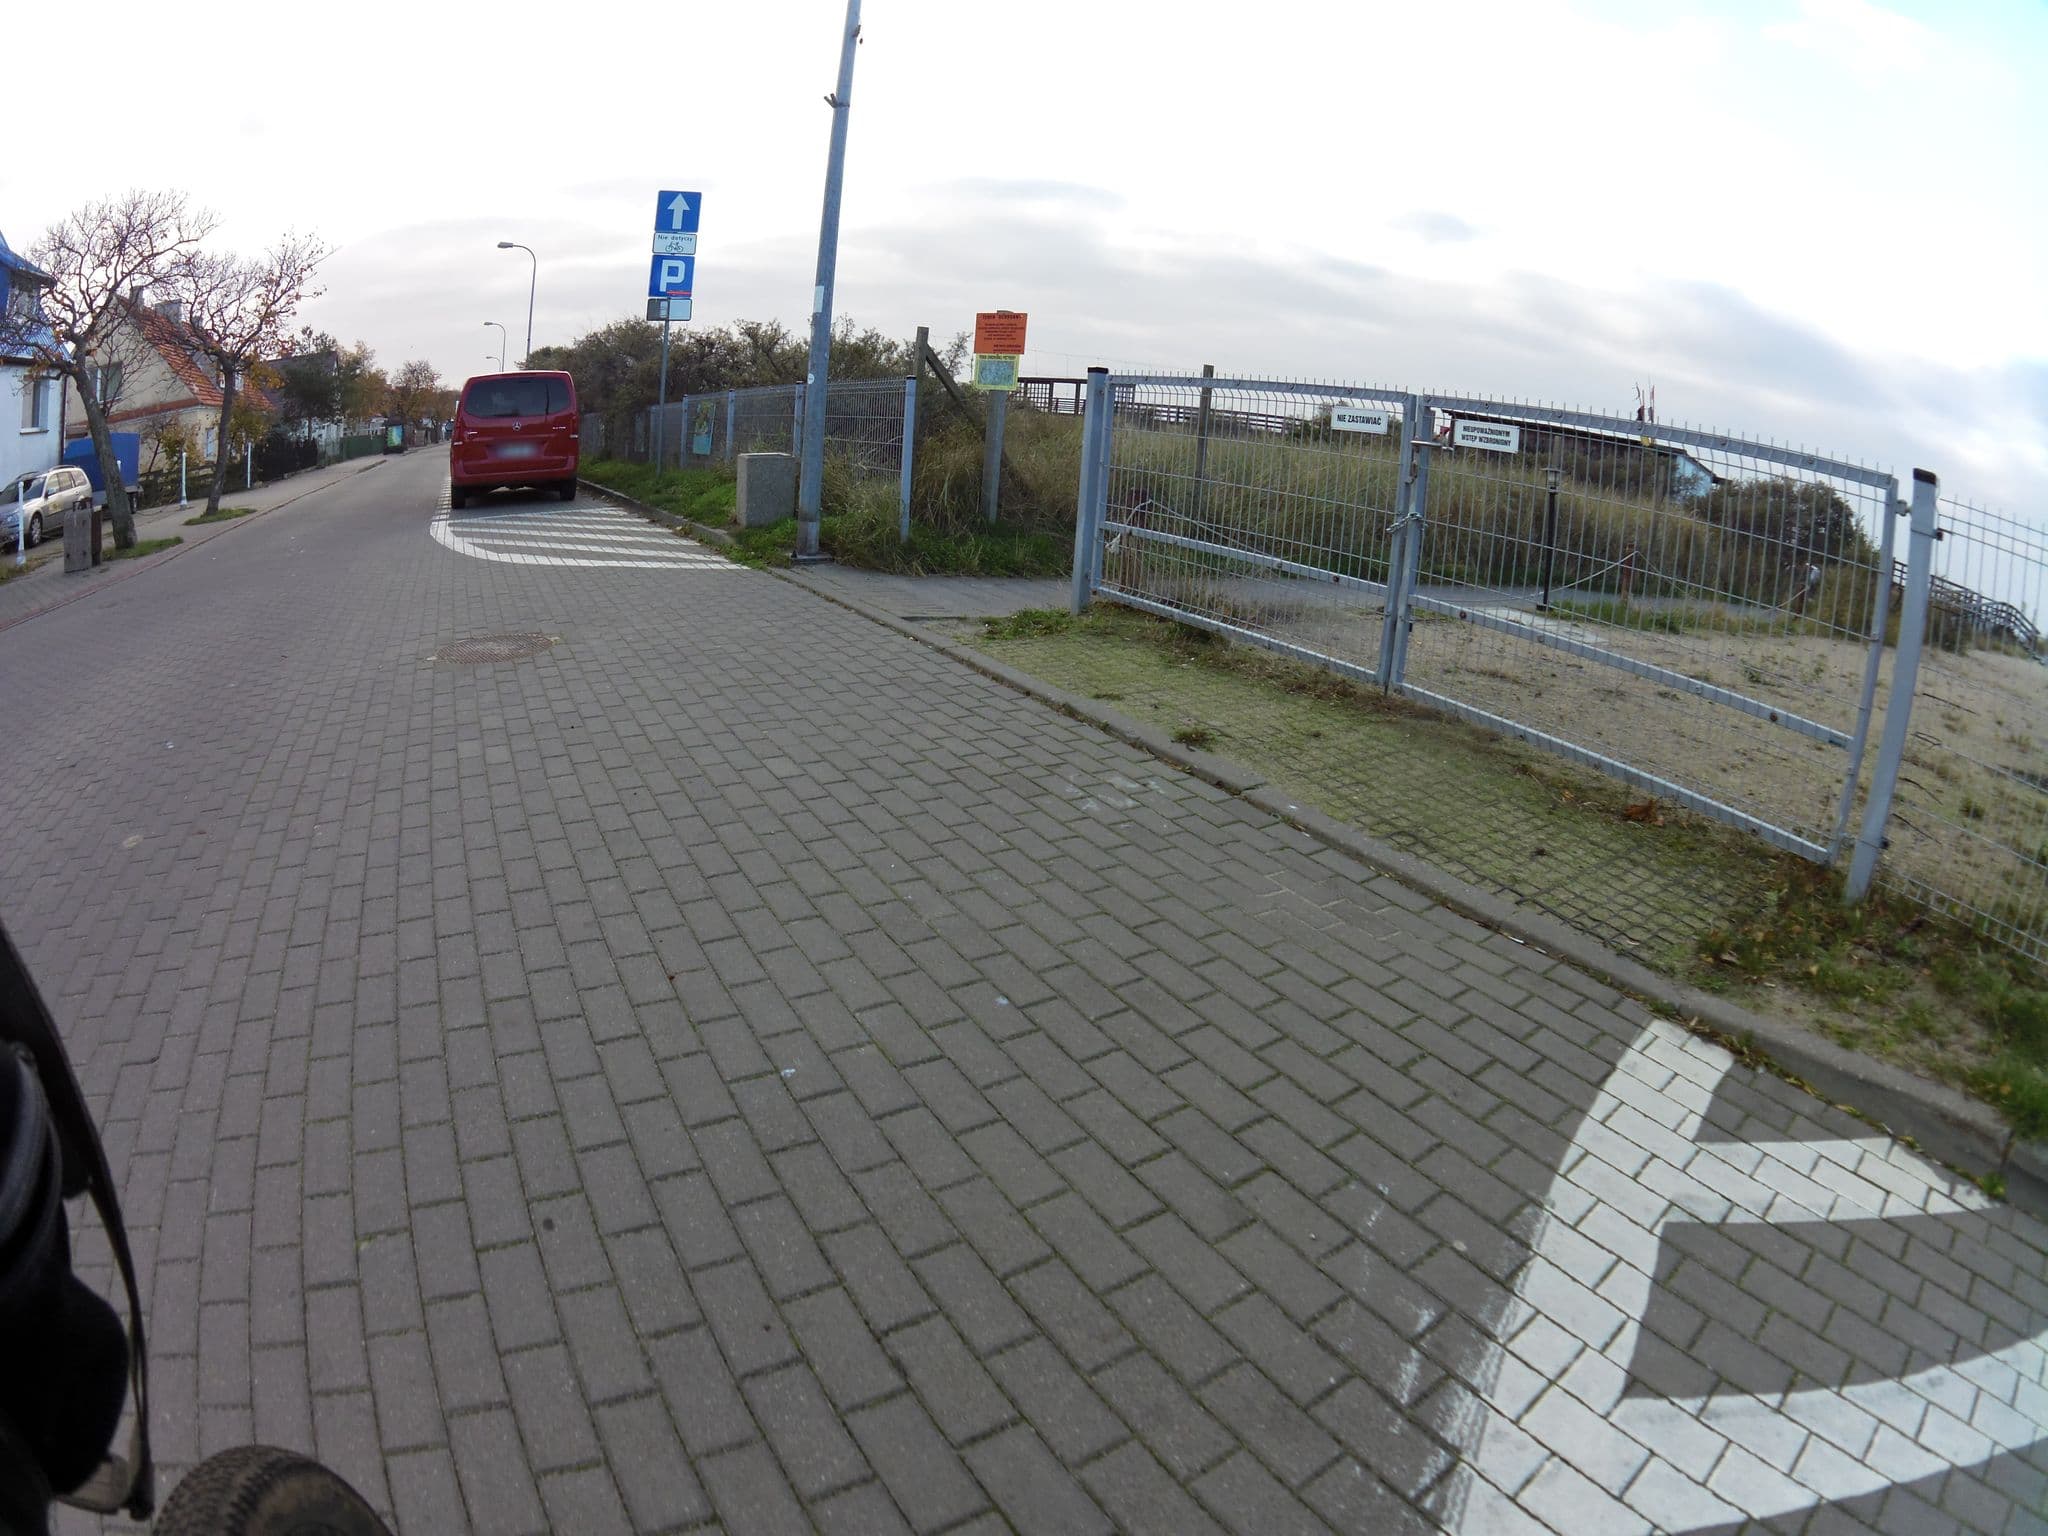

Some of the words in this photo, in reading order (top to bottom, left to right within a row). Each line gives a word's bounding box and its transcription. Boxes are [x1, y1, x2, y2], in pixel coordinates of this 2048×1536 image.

[659, 259, 686, 292] P
[1337, 414, 1347, 423] NIE
[1348, 414, 1382, 426] ZASTAWIAĆ
[1461, 433, 1477, 443] WSTĘP
